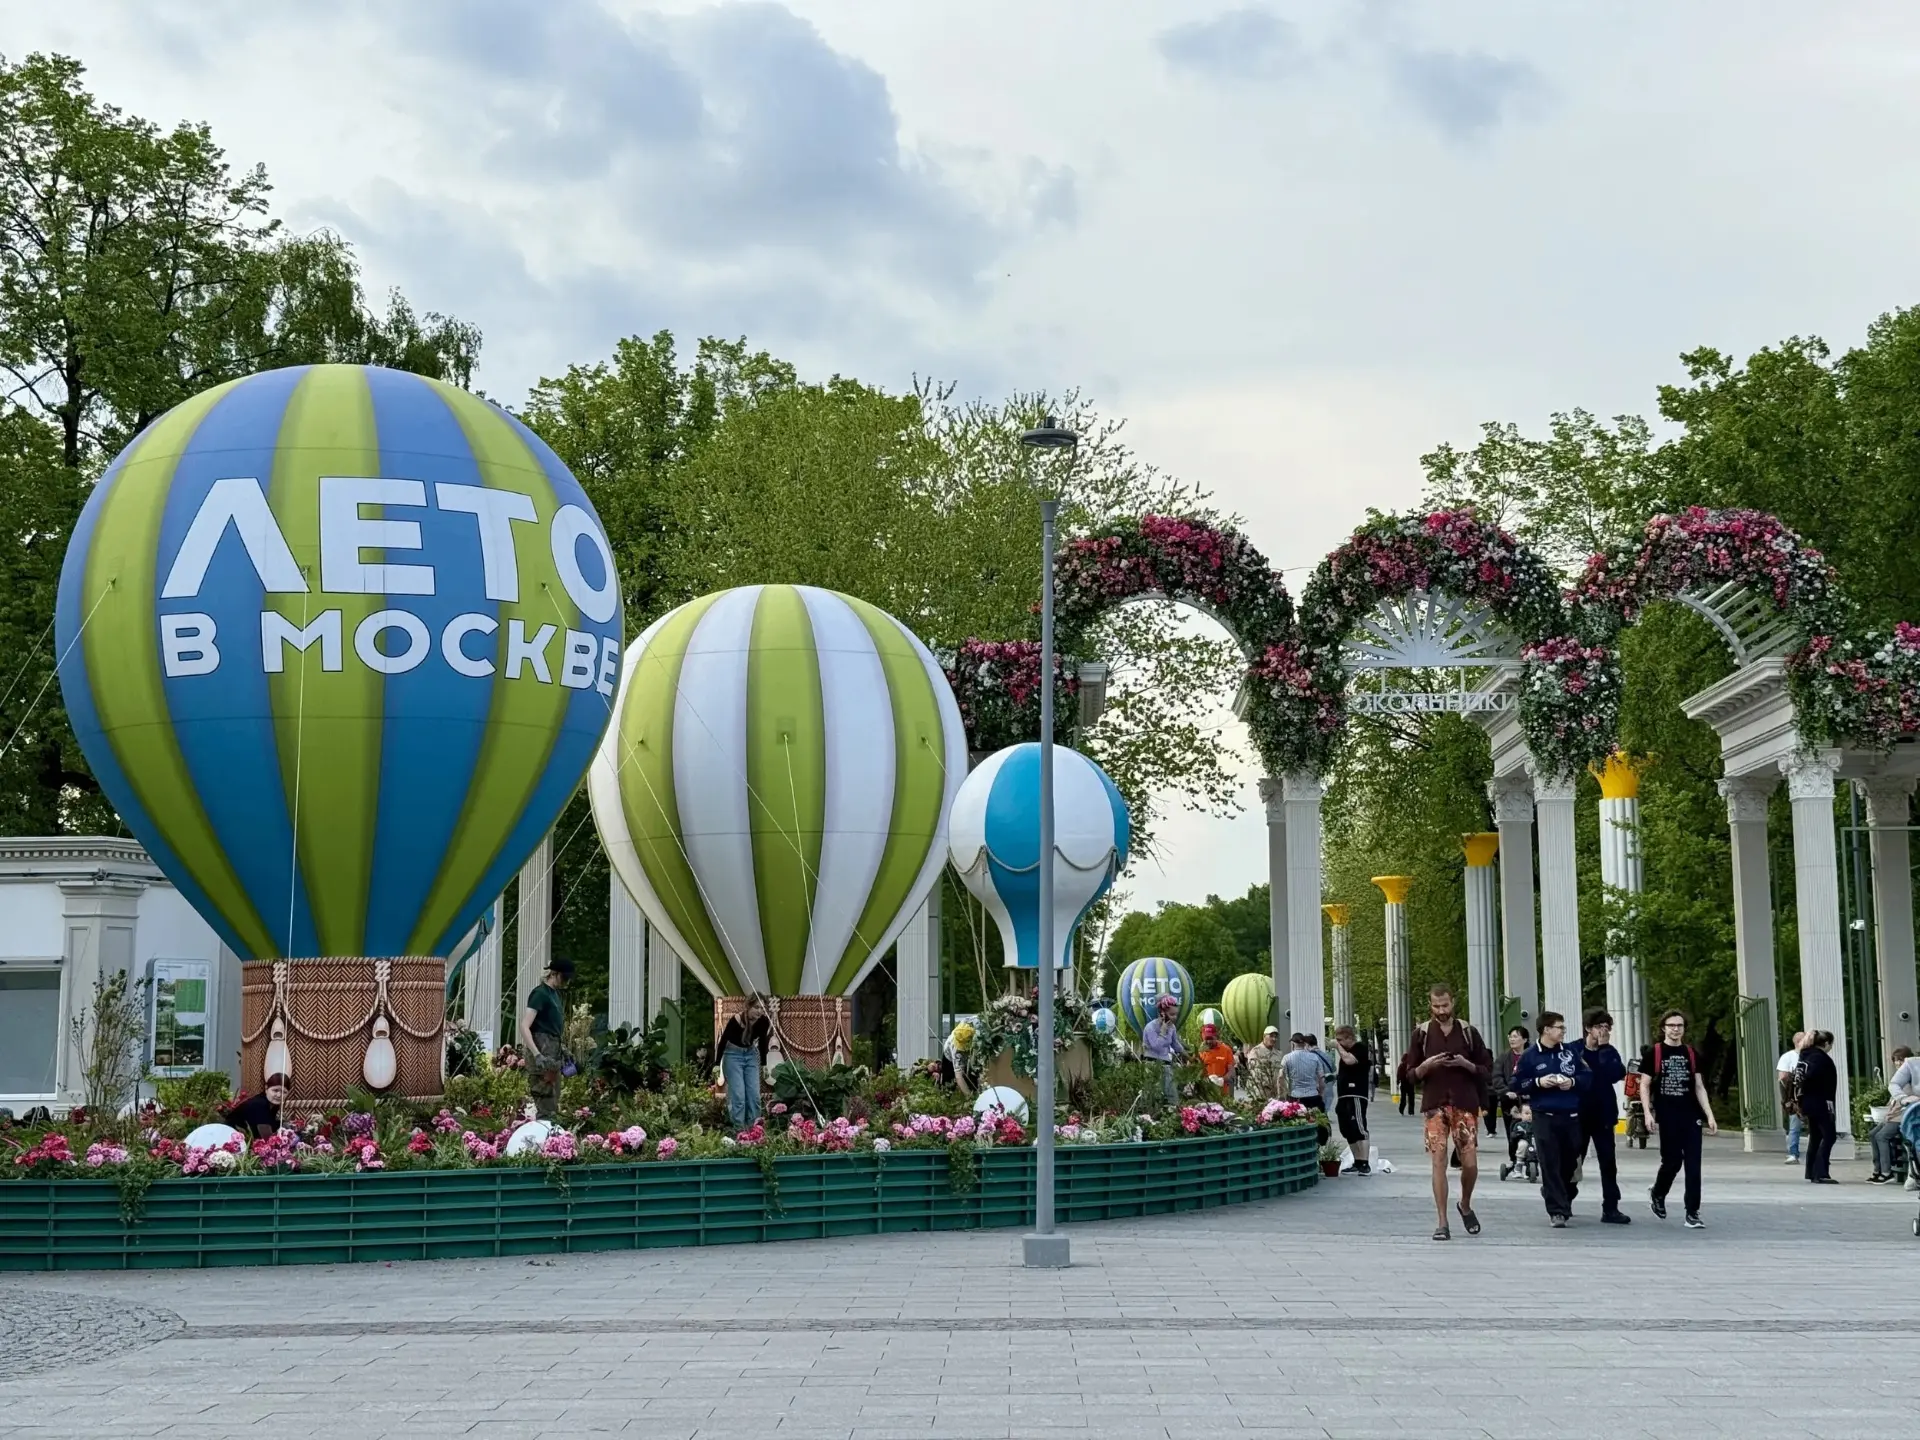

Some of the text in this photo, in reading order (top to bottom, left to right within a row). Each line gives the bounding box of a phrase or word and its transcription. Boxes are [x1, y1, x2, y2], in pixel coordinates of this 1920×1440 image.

[160, 476, 619, 624] ЛЕТО
[160, 608, 620, 697] В МОСКВЕ
[1351, 693, 1519, 712] ОКОЛЬНИКИ
[1131, 977, 1182, 994] ЛЕТО
